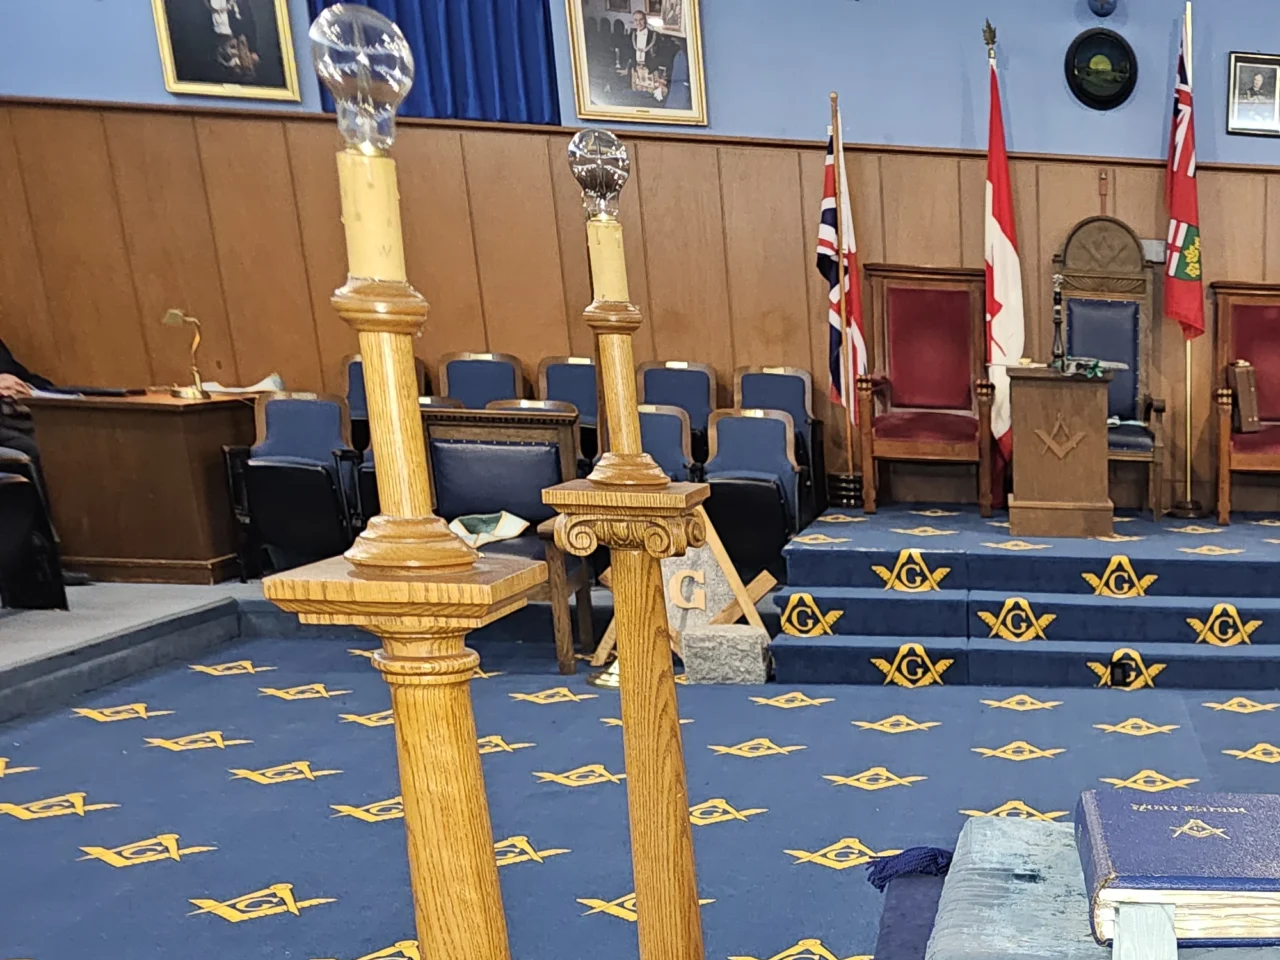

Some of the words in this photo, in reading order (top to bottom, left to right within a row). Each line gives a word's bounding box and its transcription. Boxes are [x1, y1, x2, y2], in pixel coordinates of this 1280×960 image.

[900, 564, 922, 587] G
[1109, 571, 1130, 594] G
[669, 569, 705, 611] G
[792, 606, 814, 630] G
[1006, 610, 1027, 633] G
[1213, 616, 1234, 639] G
[901, 656, 923, 680] G
[826, 848, 860, 861] G
[235, 897, 280, 911] G
